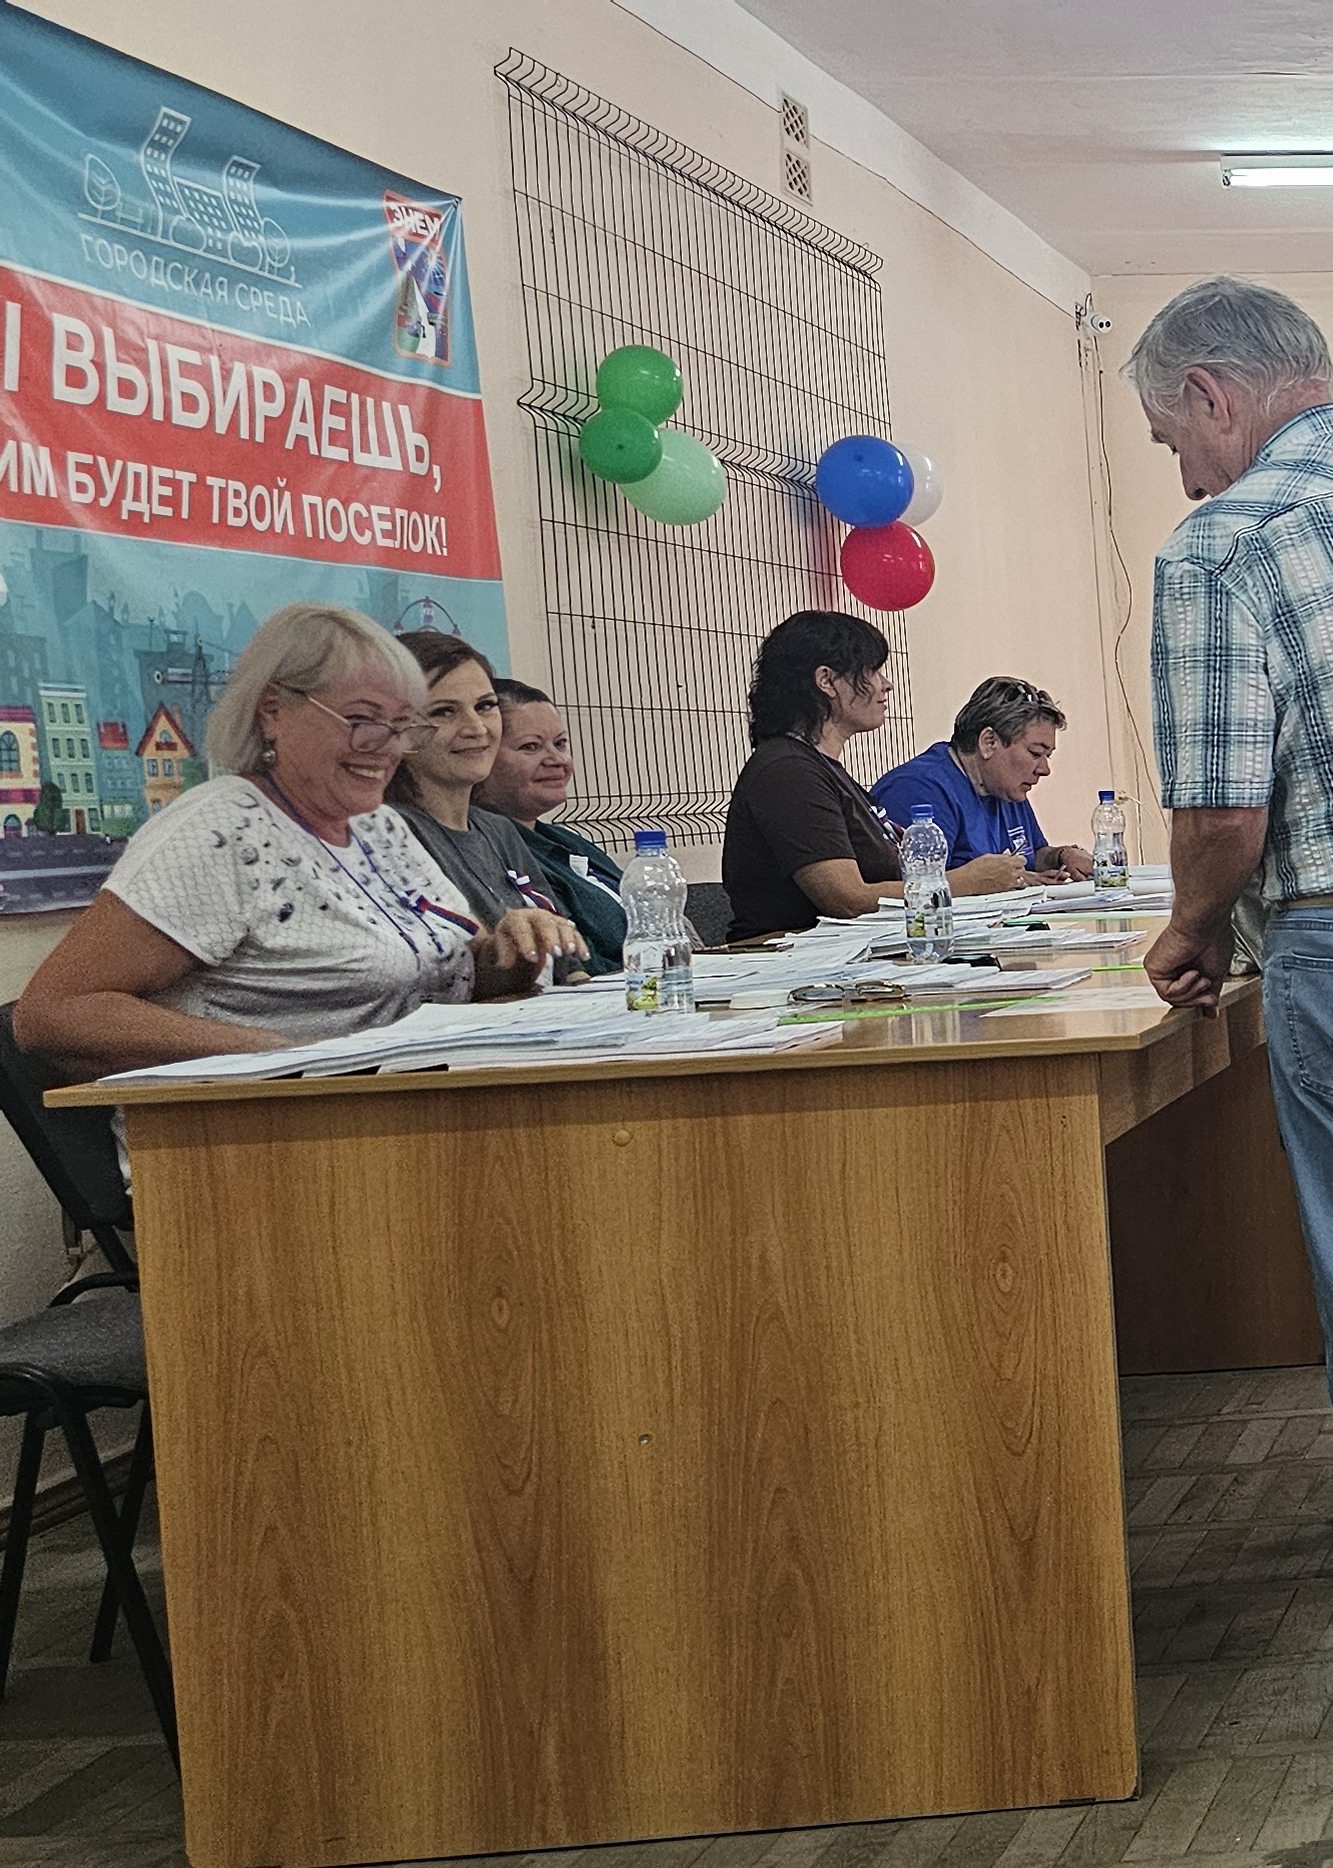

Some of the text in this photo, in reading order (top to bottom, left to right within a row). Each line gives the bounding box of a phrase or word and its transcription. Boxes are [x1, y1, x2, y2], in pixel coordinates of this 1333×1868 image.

[79, 232, 311, 329] ГОРОДСКАЯ СРЕДА
[51, 311, 442, 492] ВЫБИРАЕШЬ,
[67, 451, 197, 523] БУДЕТ
[205, 477, 295, 535] ТВОЙ
[301, 493, 448, 556] ПОСЕЛОК!
